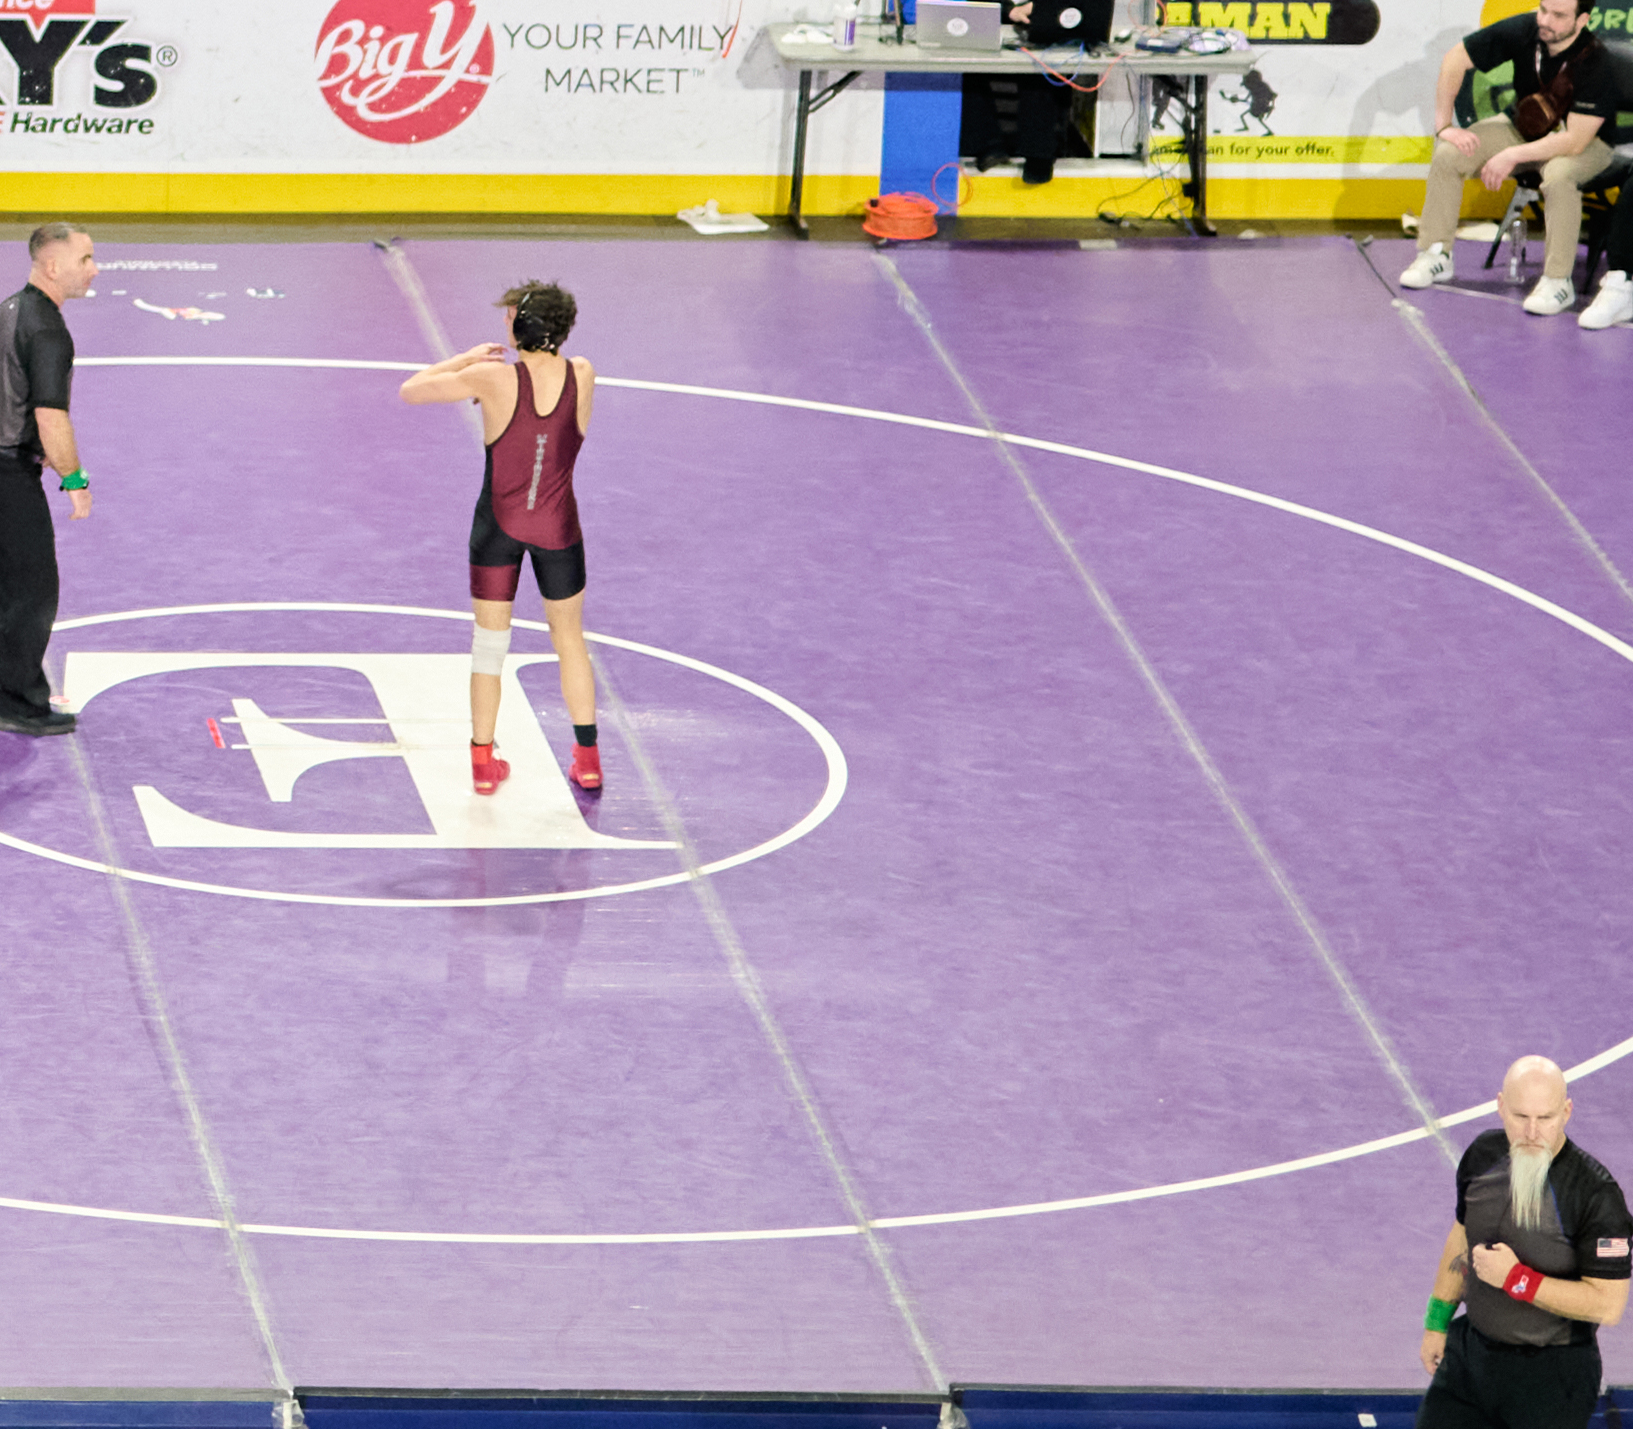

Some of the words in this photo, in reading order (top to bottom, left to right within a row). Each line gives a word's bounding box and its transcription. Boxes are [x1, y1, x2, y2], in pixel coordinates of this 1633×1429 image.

[502, 23, 603, 50] YOUR
[615, 24, 736, 51] FAMILY
[314, 18, 418, 102] Big
[10, 111, 155, 136] Hardware
[1230, 143, 1250, 157] for
[1255, 146, 1289, 158] your
[1294, 143, 1336, 156] offer.
